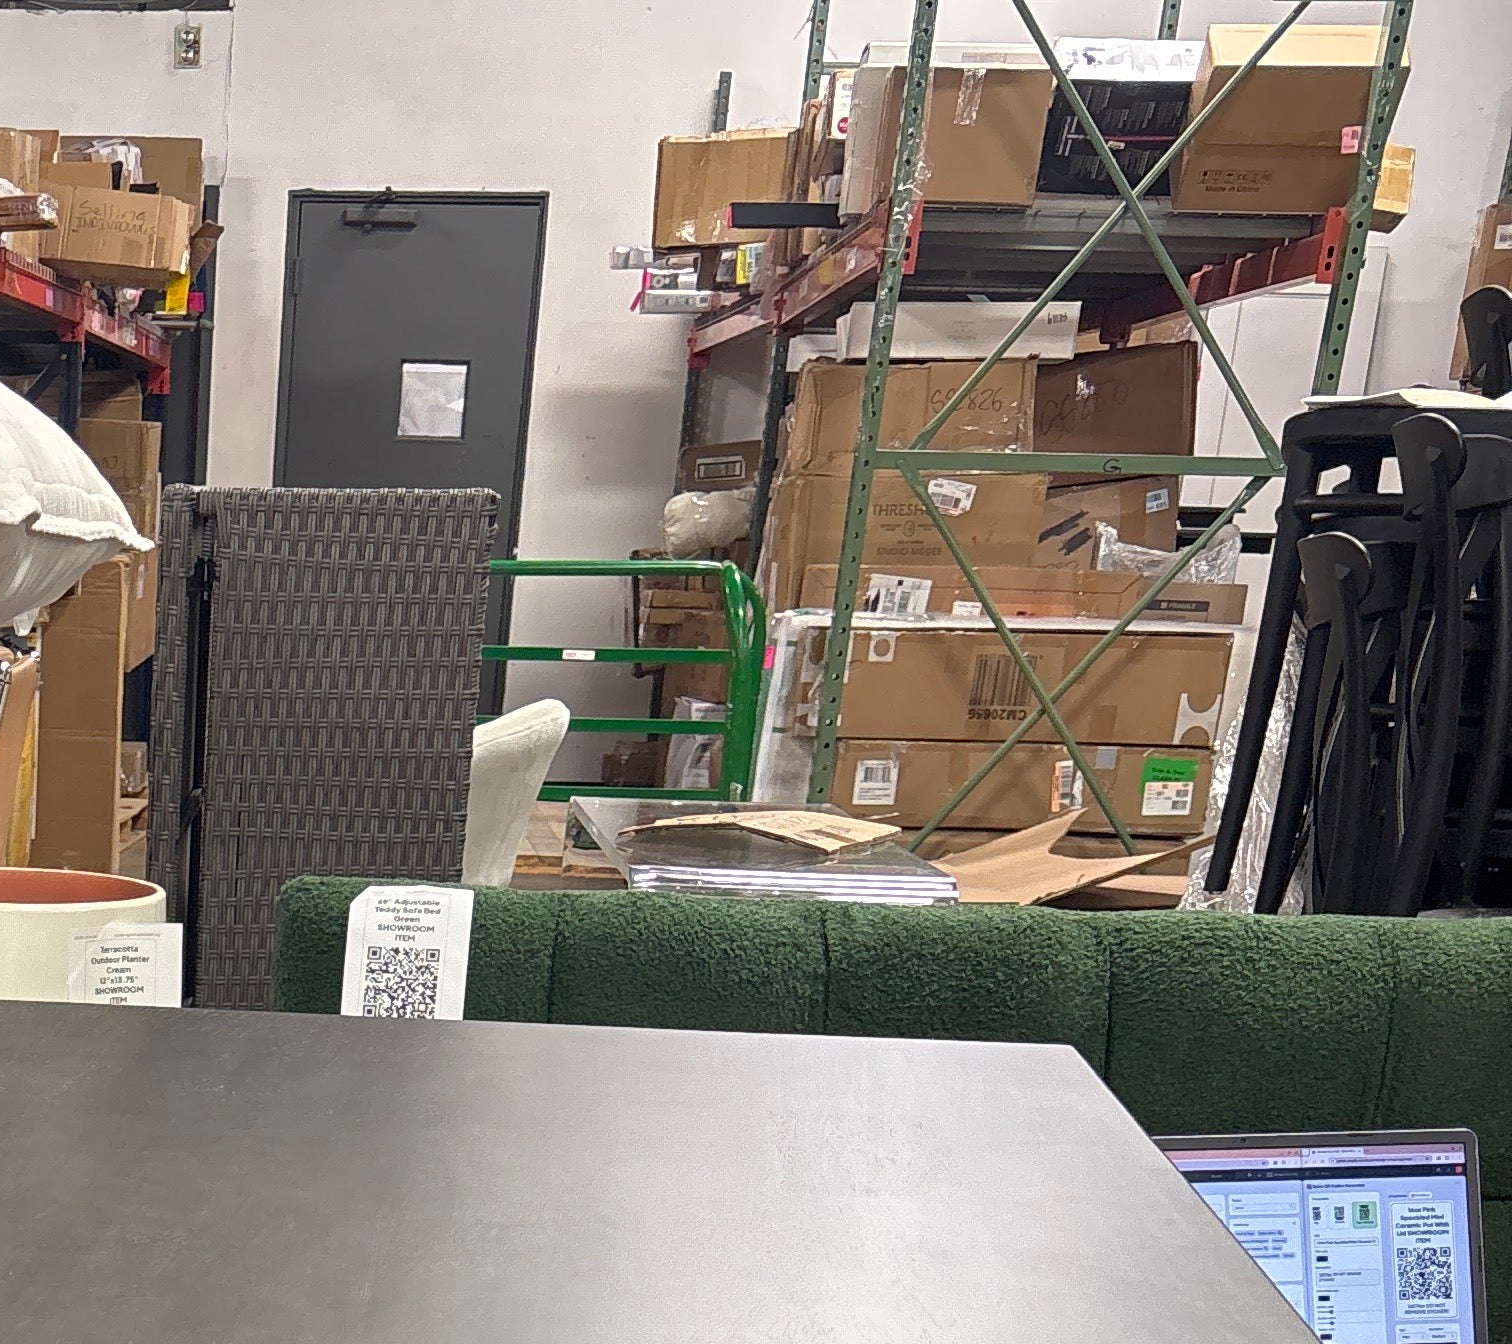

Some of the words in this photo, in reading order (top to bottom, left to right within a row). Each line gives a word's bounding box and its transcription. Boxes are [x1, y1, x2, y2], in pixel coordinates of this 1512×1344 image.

[872, 503, 925, 517] THRESH
[393, 898, 441, 907] Adjustable
[375, 906, 402, 915] Teddy
[402, 906, 423, 914] Sofa
[423, 907, 442, 915] Bed
[393, 915, 421, 923] Green
[377, 923, 436, 933] SHOWROOM
[394, 934, 416, 943] ITEM
[99, 945, 139, 954] Terracotta
[90, 956, 121, 965] Outdoor
[121, 955, 150, 963] Planter
[106, 966, 132, 975] Cream
[94, 985, 145, 996] SHOWROOM
